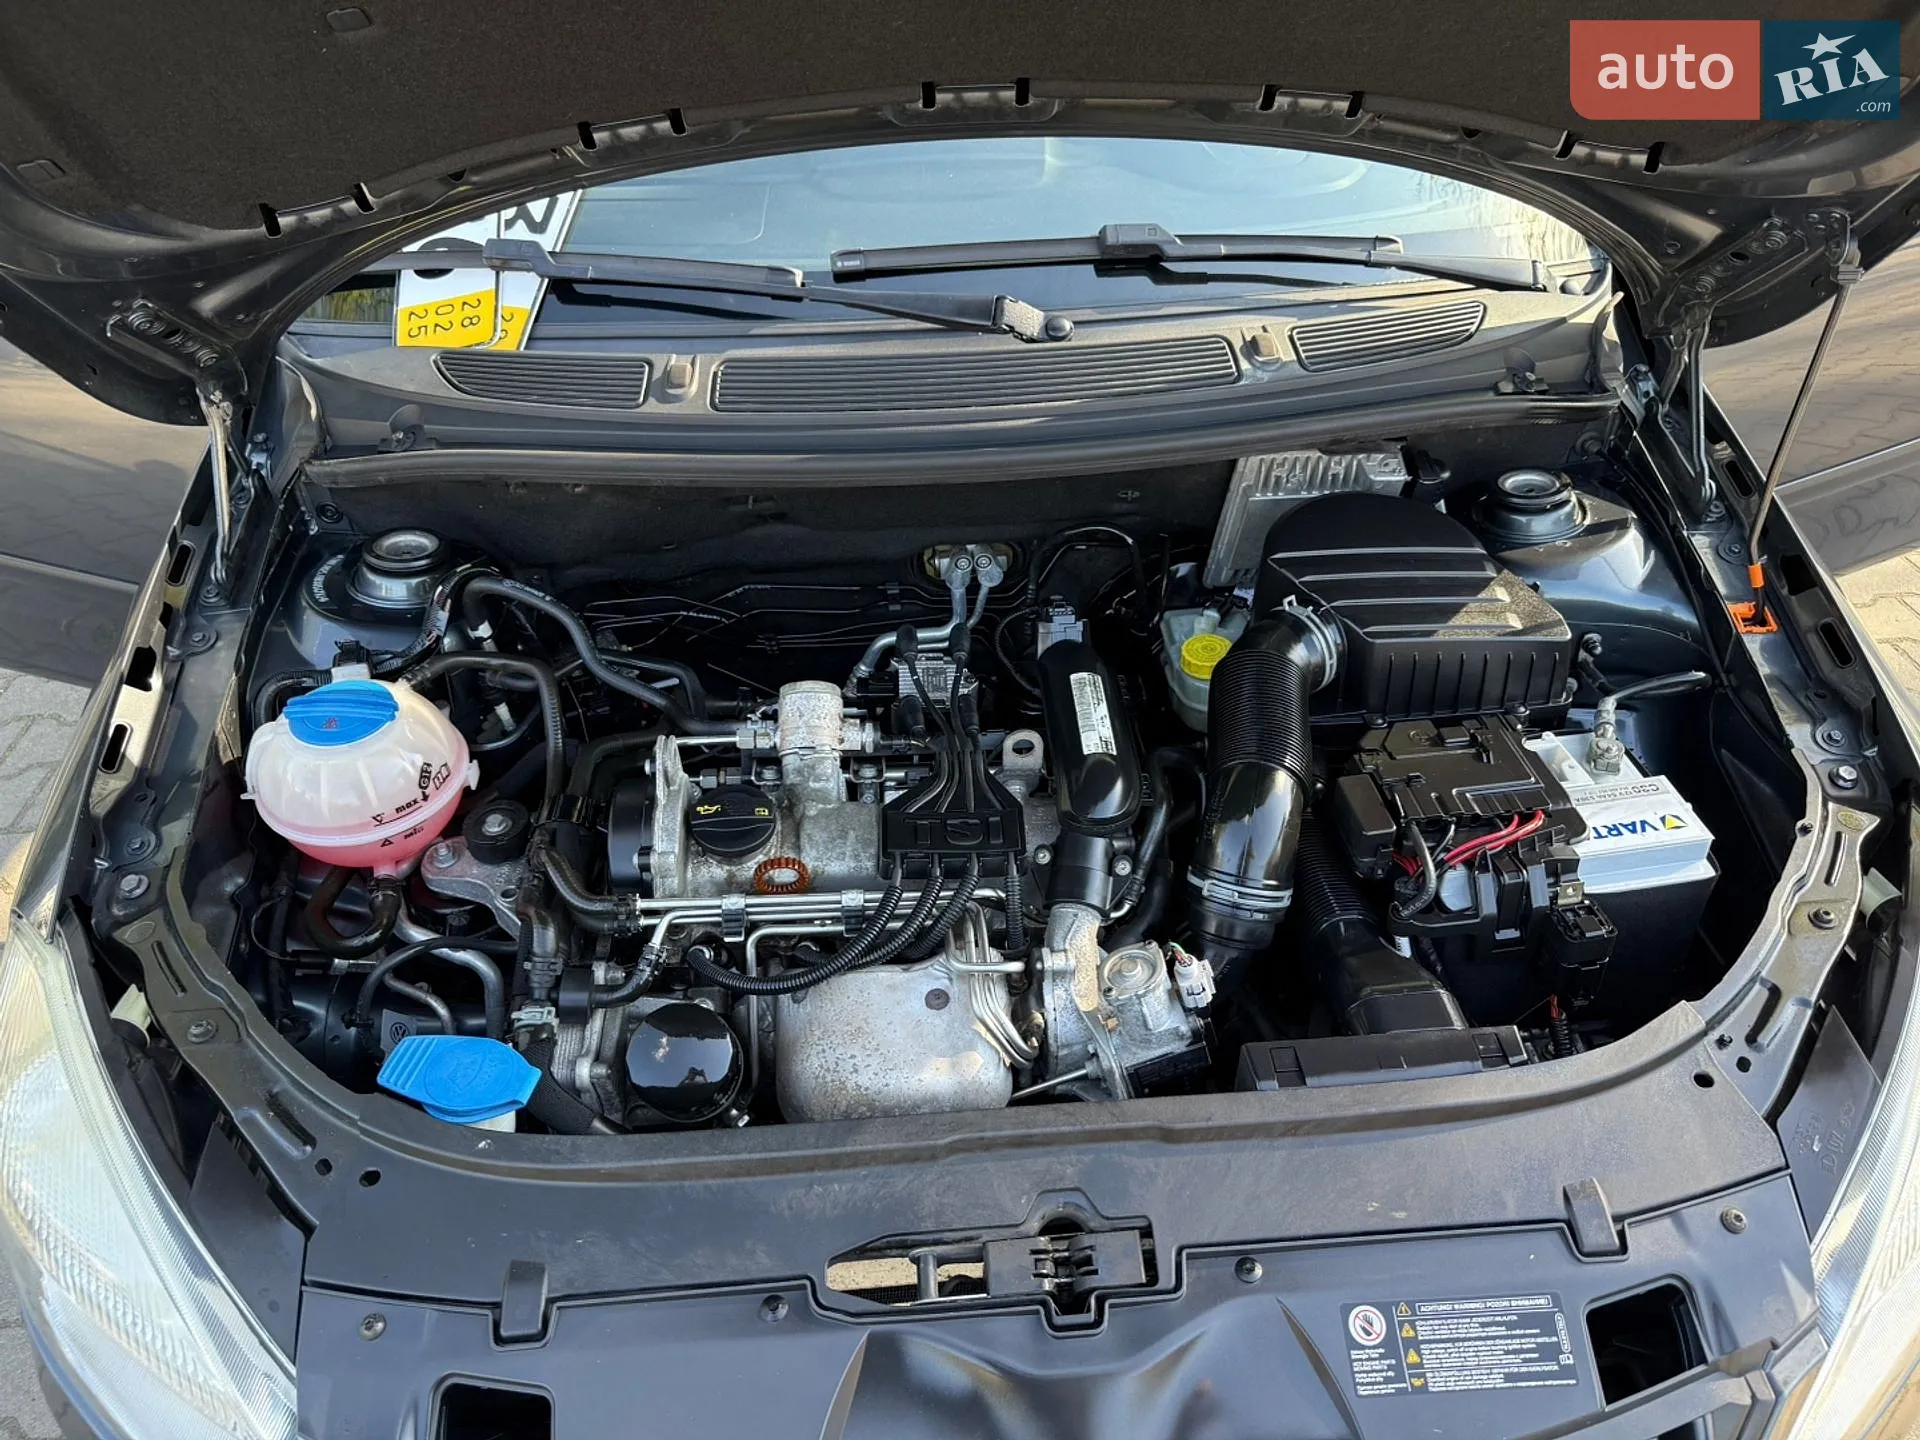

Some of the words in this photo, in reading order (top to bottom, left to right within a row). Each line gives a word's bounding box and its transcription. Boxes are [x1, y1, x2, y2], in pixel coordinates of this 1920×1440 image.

[408, 309, 428, 338] 25
[434, 304, 455, 335] 02
[461, 298, 481, 328] 28
[395, 798, 420, 814] max
[903, 815, 1004, 845] TSI
[1591, 819, 1660, 840] VART
